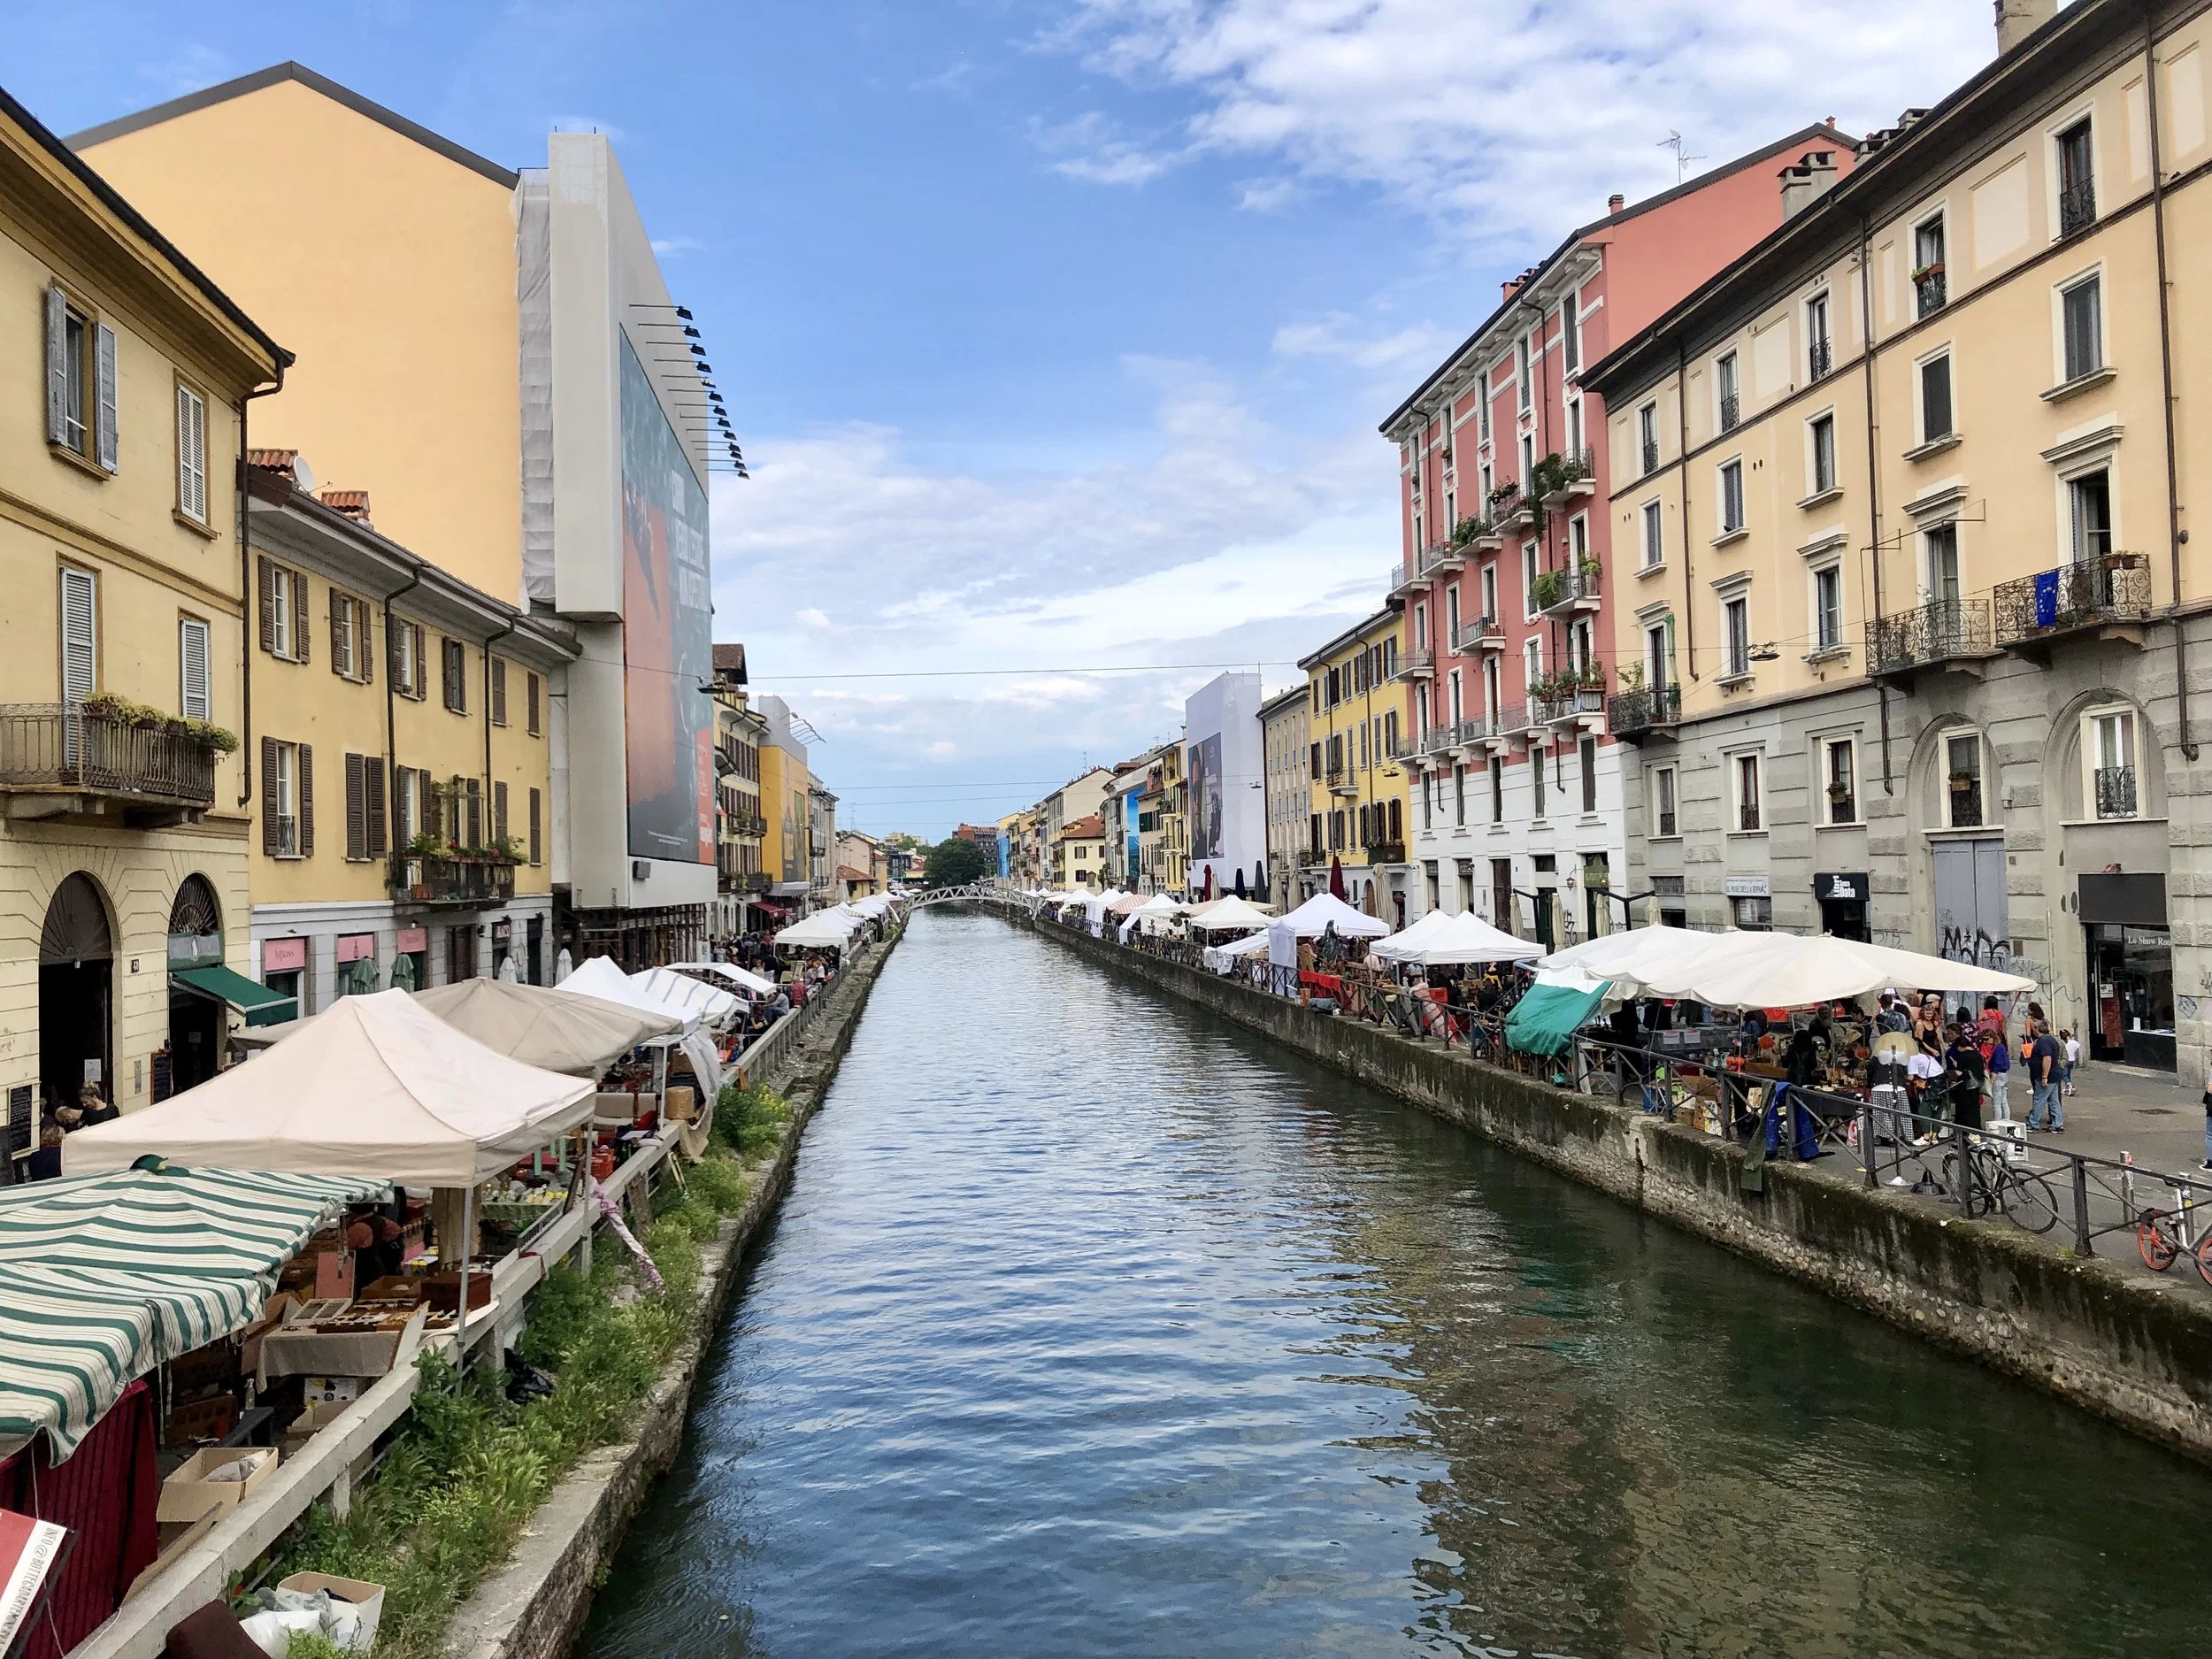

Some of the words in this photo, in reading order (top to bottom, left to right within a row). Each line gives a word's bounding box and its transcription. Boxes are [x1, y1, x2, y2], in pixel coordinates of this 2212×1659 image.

[1839, 887, 1855, 898] Data
[2128, 935, 2138, 944] Lo
[2138, 936, 2155, 945] Show
